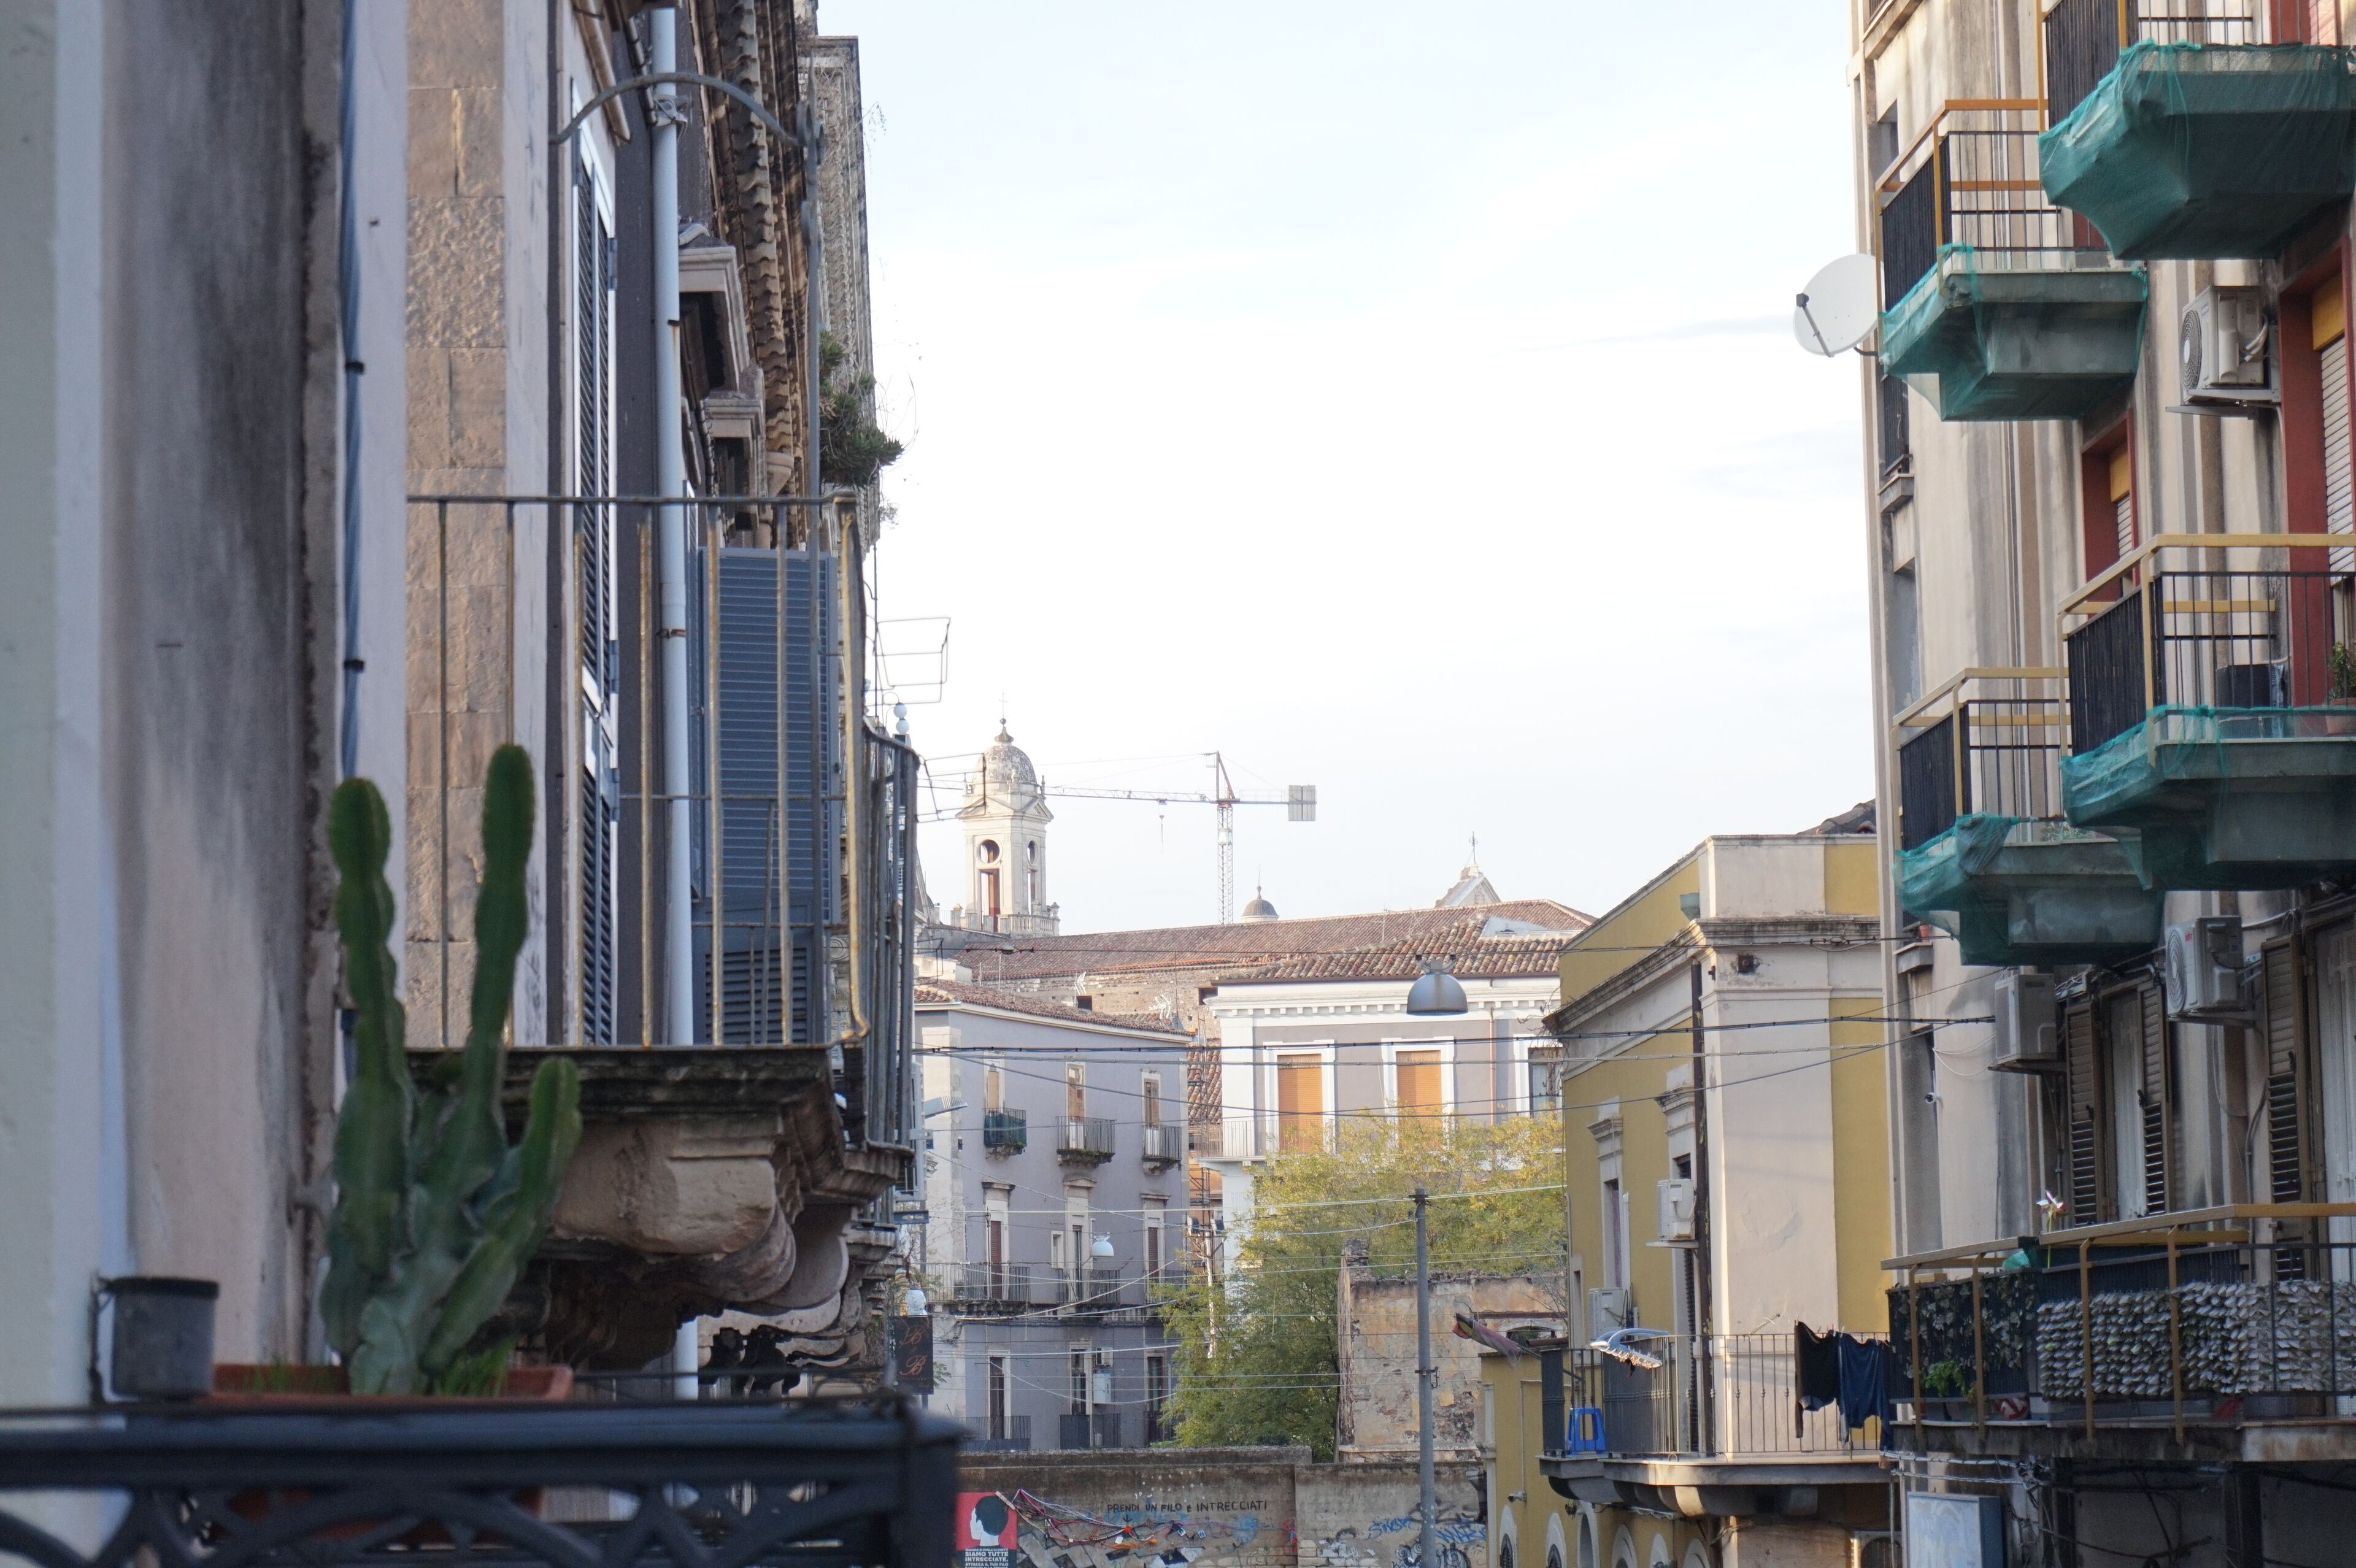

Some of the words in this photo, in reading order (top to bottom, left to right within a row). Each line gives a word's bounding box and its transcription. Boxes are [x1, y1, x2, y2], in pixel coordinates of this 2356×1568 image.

[899, 1355, 928, 1375] B
[1107, 1504, 1139, 1513] PRENDI
[1145, 1503, 1157, 1512] UN
[1161, 1503, 1182, 1513] FILO
[1197, 1500, 1268, 1513] INTRECCIATI
